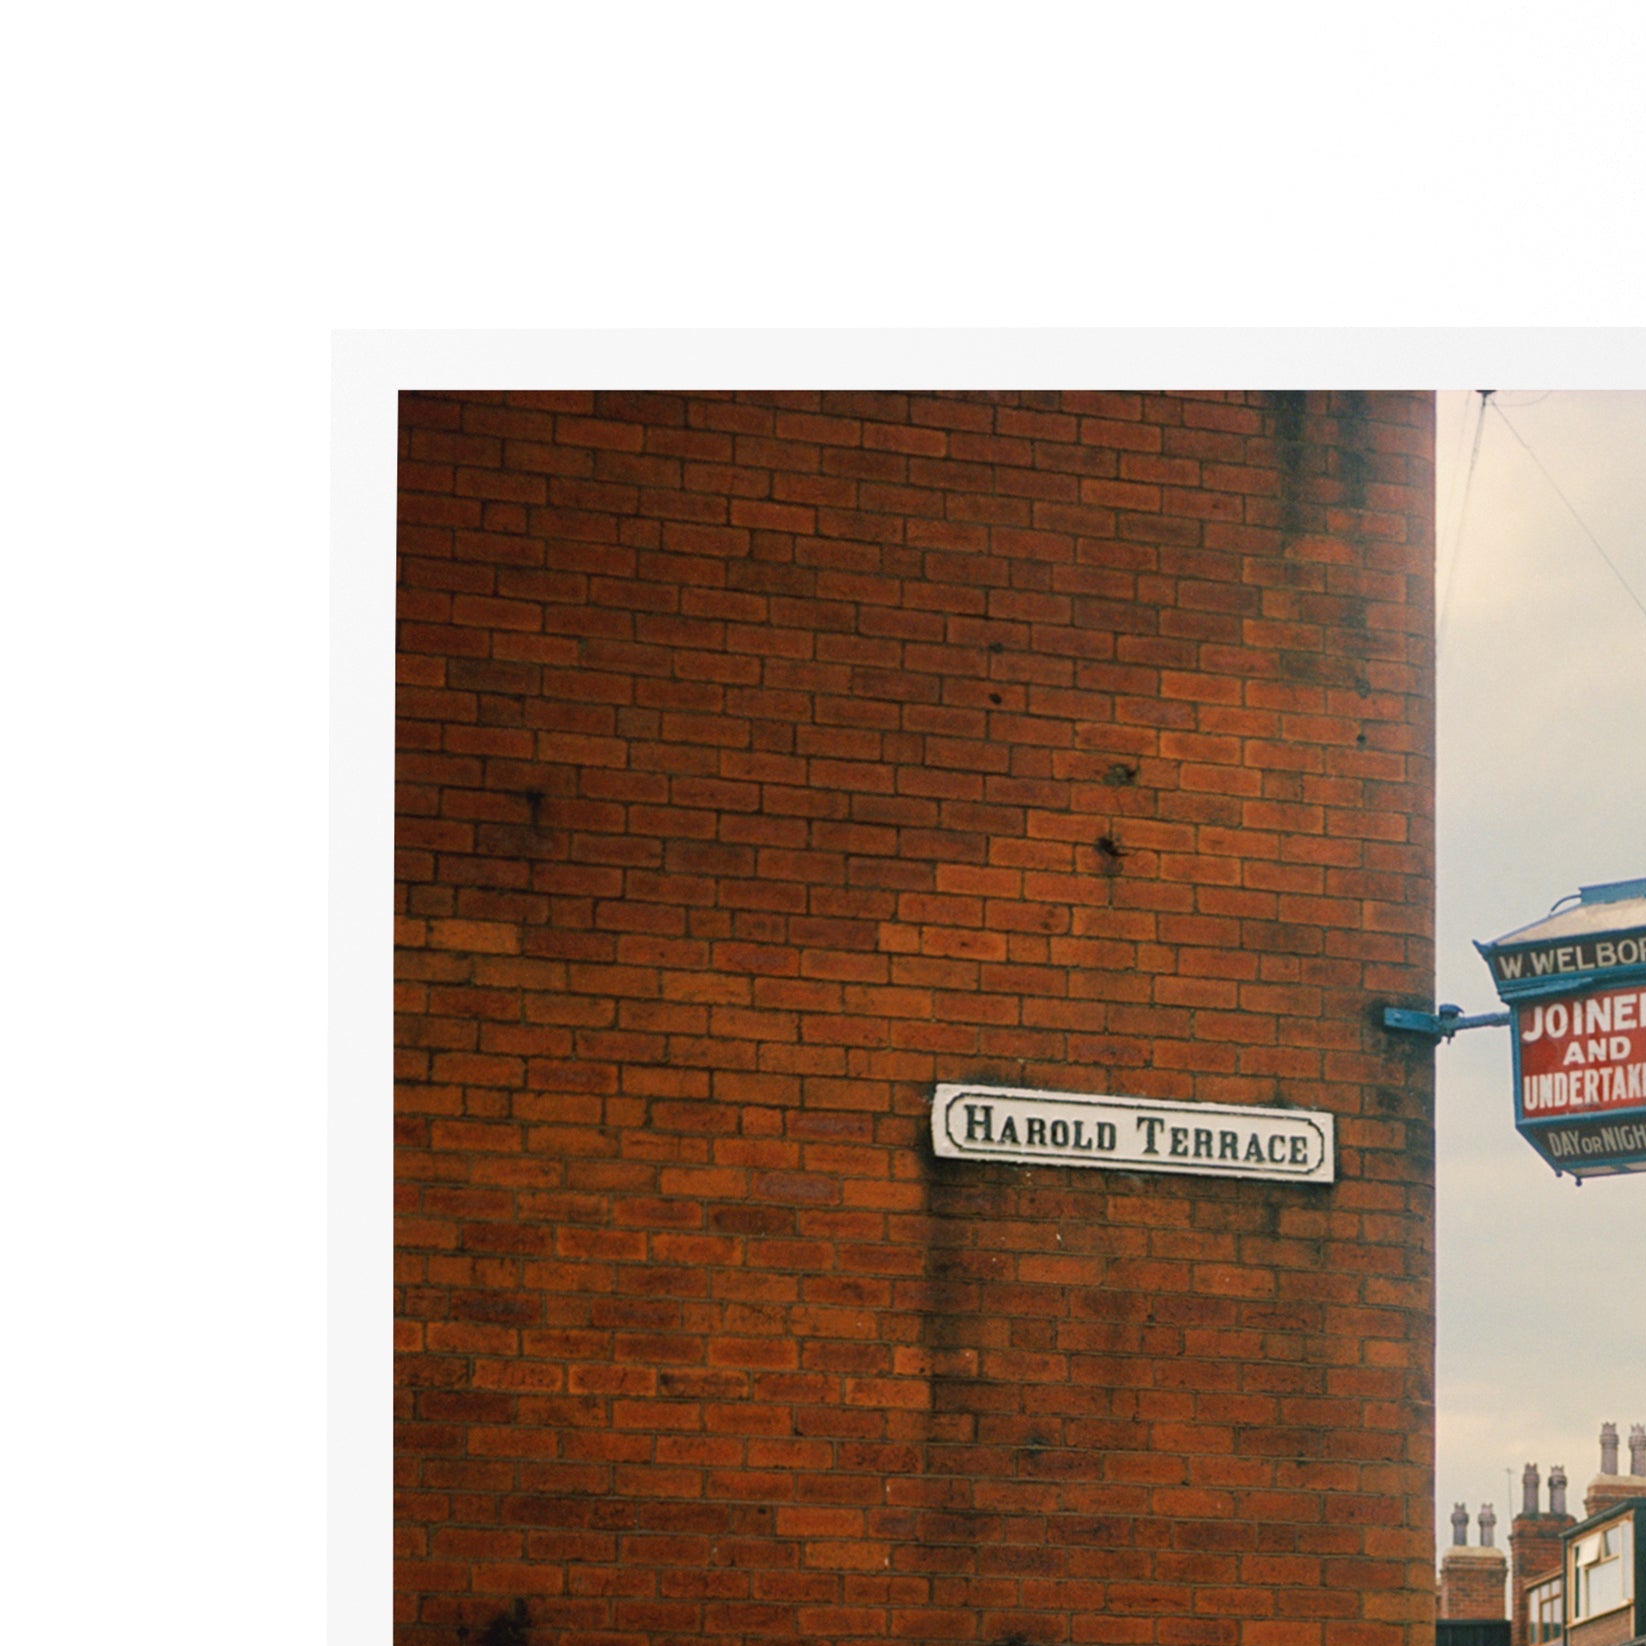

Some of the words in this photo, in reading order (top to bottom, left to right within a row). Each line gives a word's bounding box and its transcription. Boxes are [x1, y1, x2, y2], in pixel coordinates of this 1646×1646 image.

[1562, 1036, 1632, 1066] AND
[963, 1104, 1118, 1152] HAROLD
[1136, 1116, 1309, 1166] TERRACE
[1547, 1130, 1581, 1157] DAY
